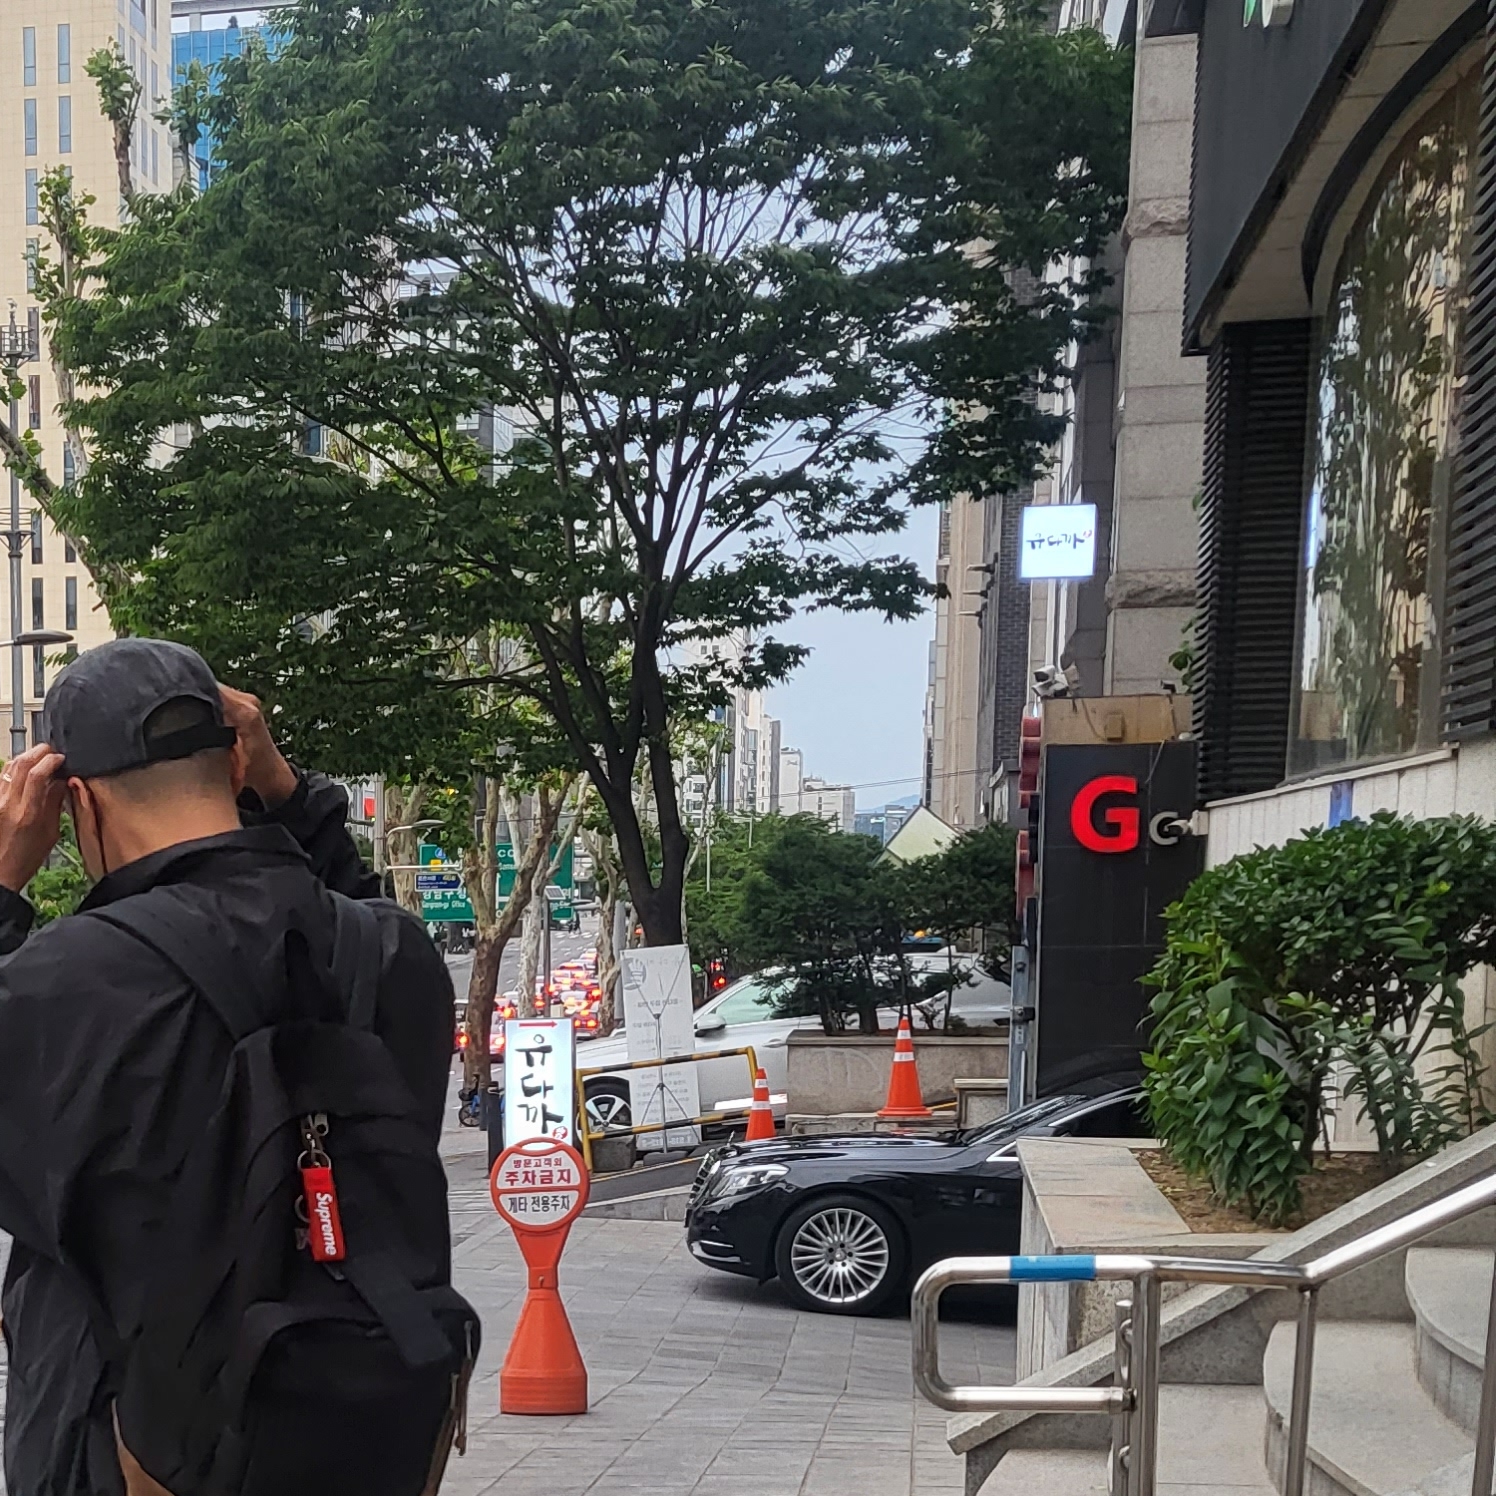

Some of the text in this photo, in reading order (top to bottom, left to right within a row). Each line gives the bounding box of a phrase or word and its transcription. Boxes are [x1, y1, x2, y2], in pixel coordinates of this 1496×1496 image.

[1071, 775, 1140, 853] G
[514, 1034, 565, 1134] 유다까
[314, 1192, 337, 1256] Supreme
